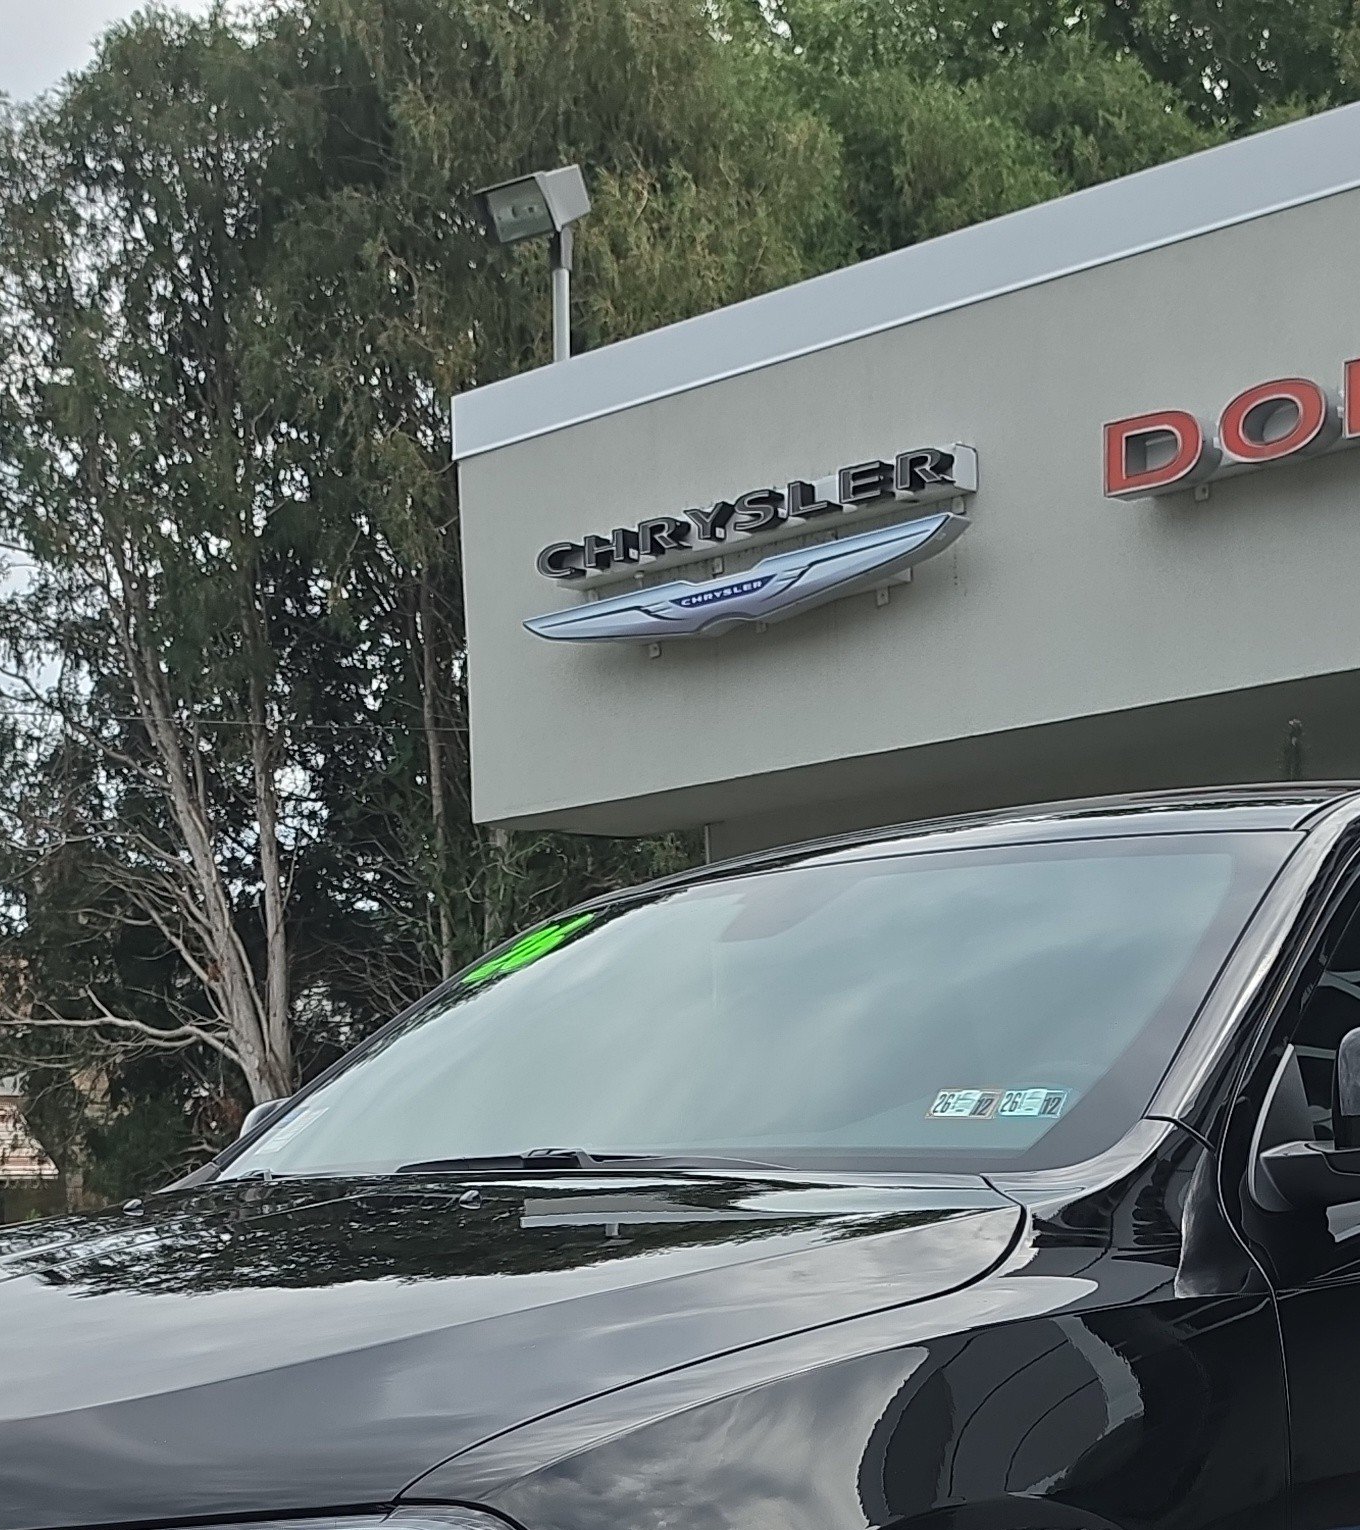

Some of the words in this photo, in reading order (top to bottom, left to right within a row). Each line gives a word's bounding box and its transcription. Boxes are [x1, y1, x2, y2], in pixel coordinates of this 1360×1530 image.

[536, 446, 958, 578] CHRYSLER
[681, 581, 762, 606] CHRYSLER
[933, 1093, 955, 1113] 26
[971, 1097, 994, 1116] 12
[1000, 1092, 1022, 1112] 26
[1041, 1096, 1062, 1115] 12
